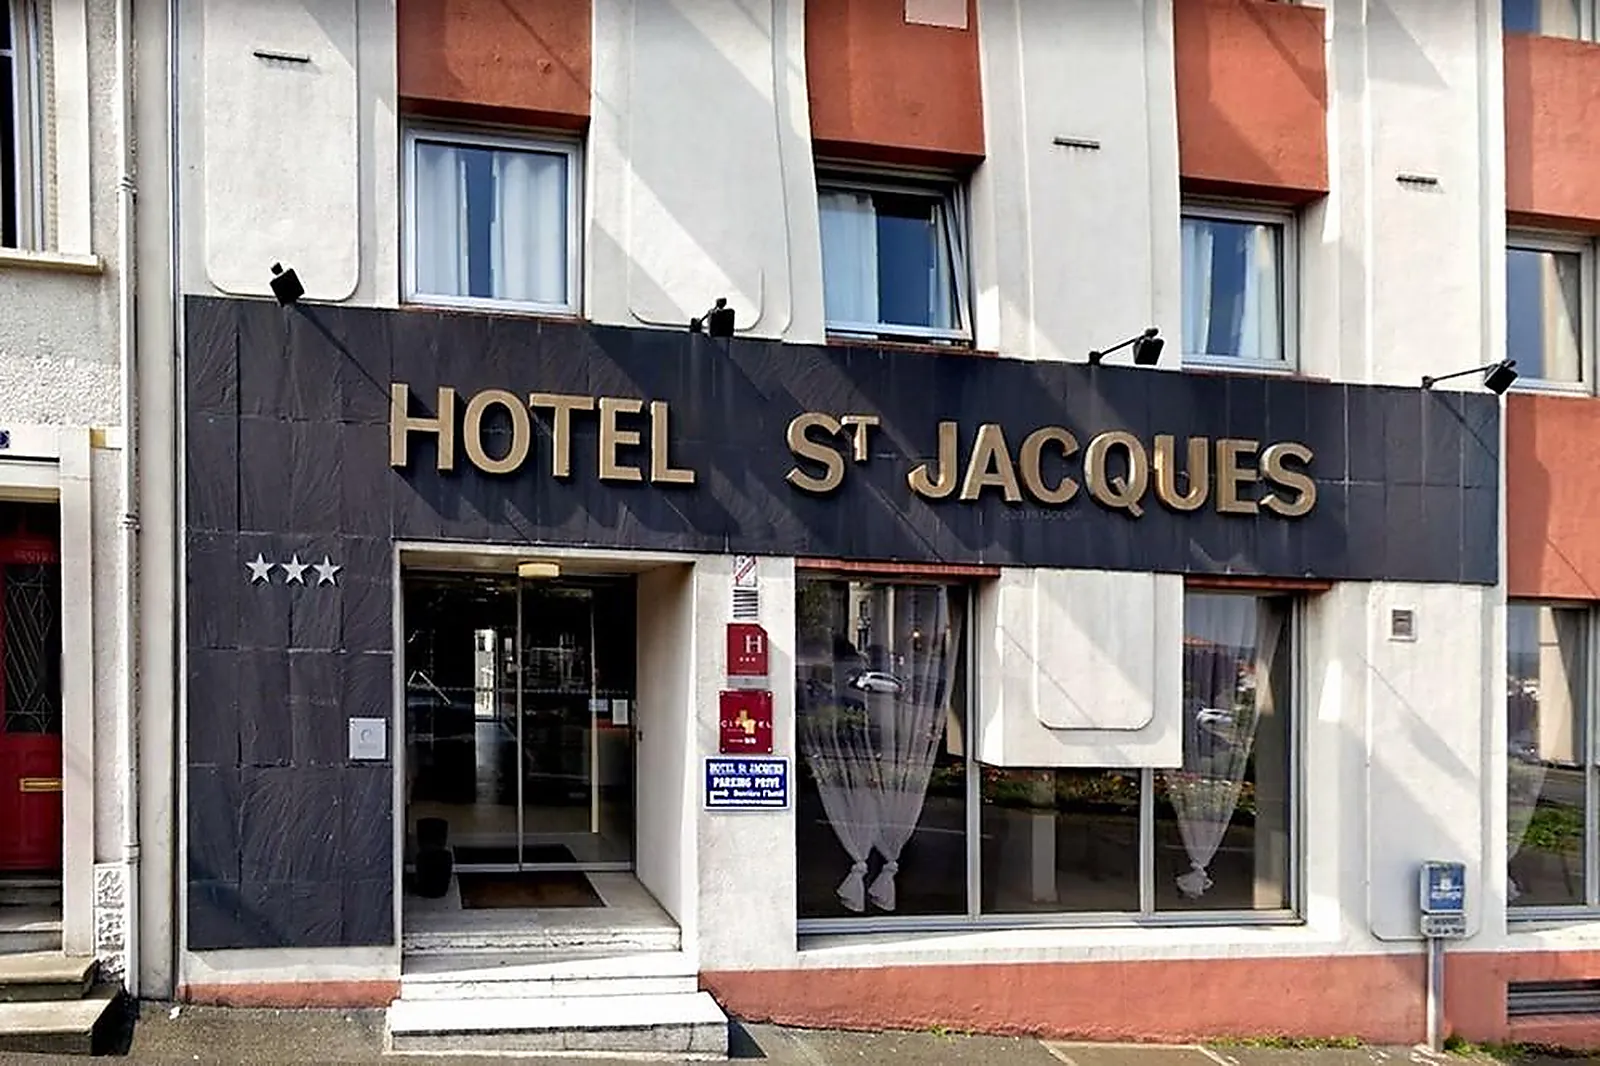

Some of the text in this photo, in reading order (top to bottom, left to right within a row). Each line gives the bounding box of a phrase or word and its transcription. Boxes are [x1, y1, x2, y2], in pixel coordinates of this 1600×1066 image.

[390, 382, 696, 484] HOTEL
[906, 420, 1317, 519] JACQUES
[745, 634, 762, 654] H
[713, 777, 752, 788] PARKING
